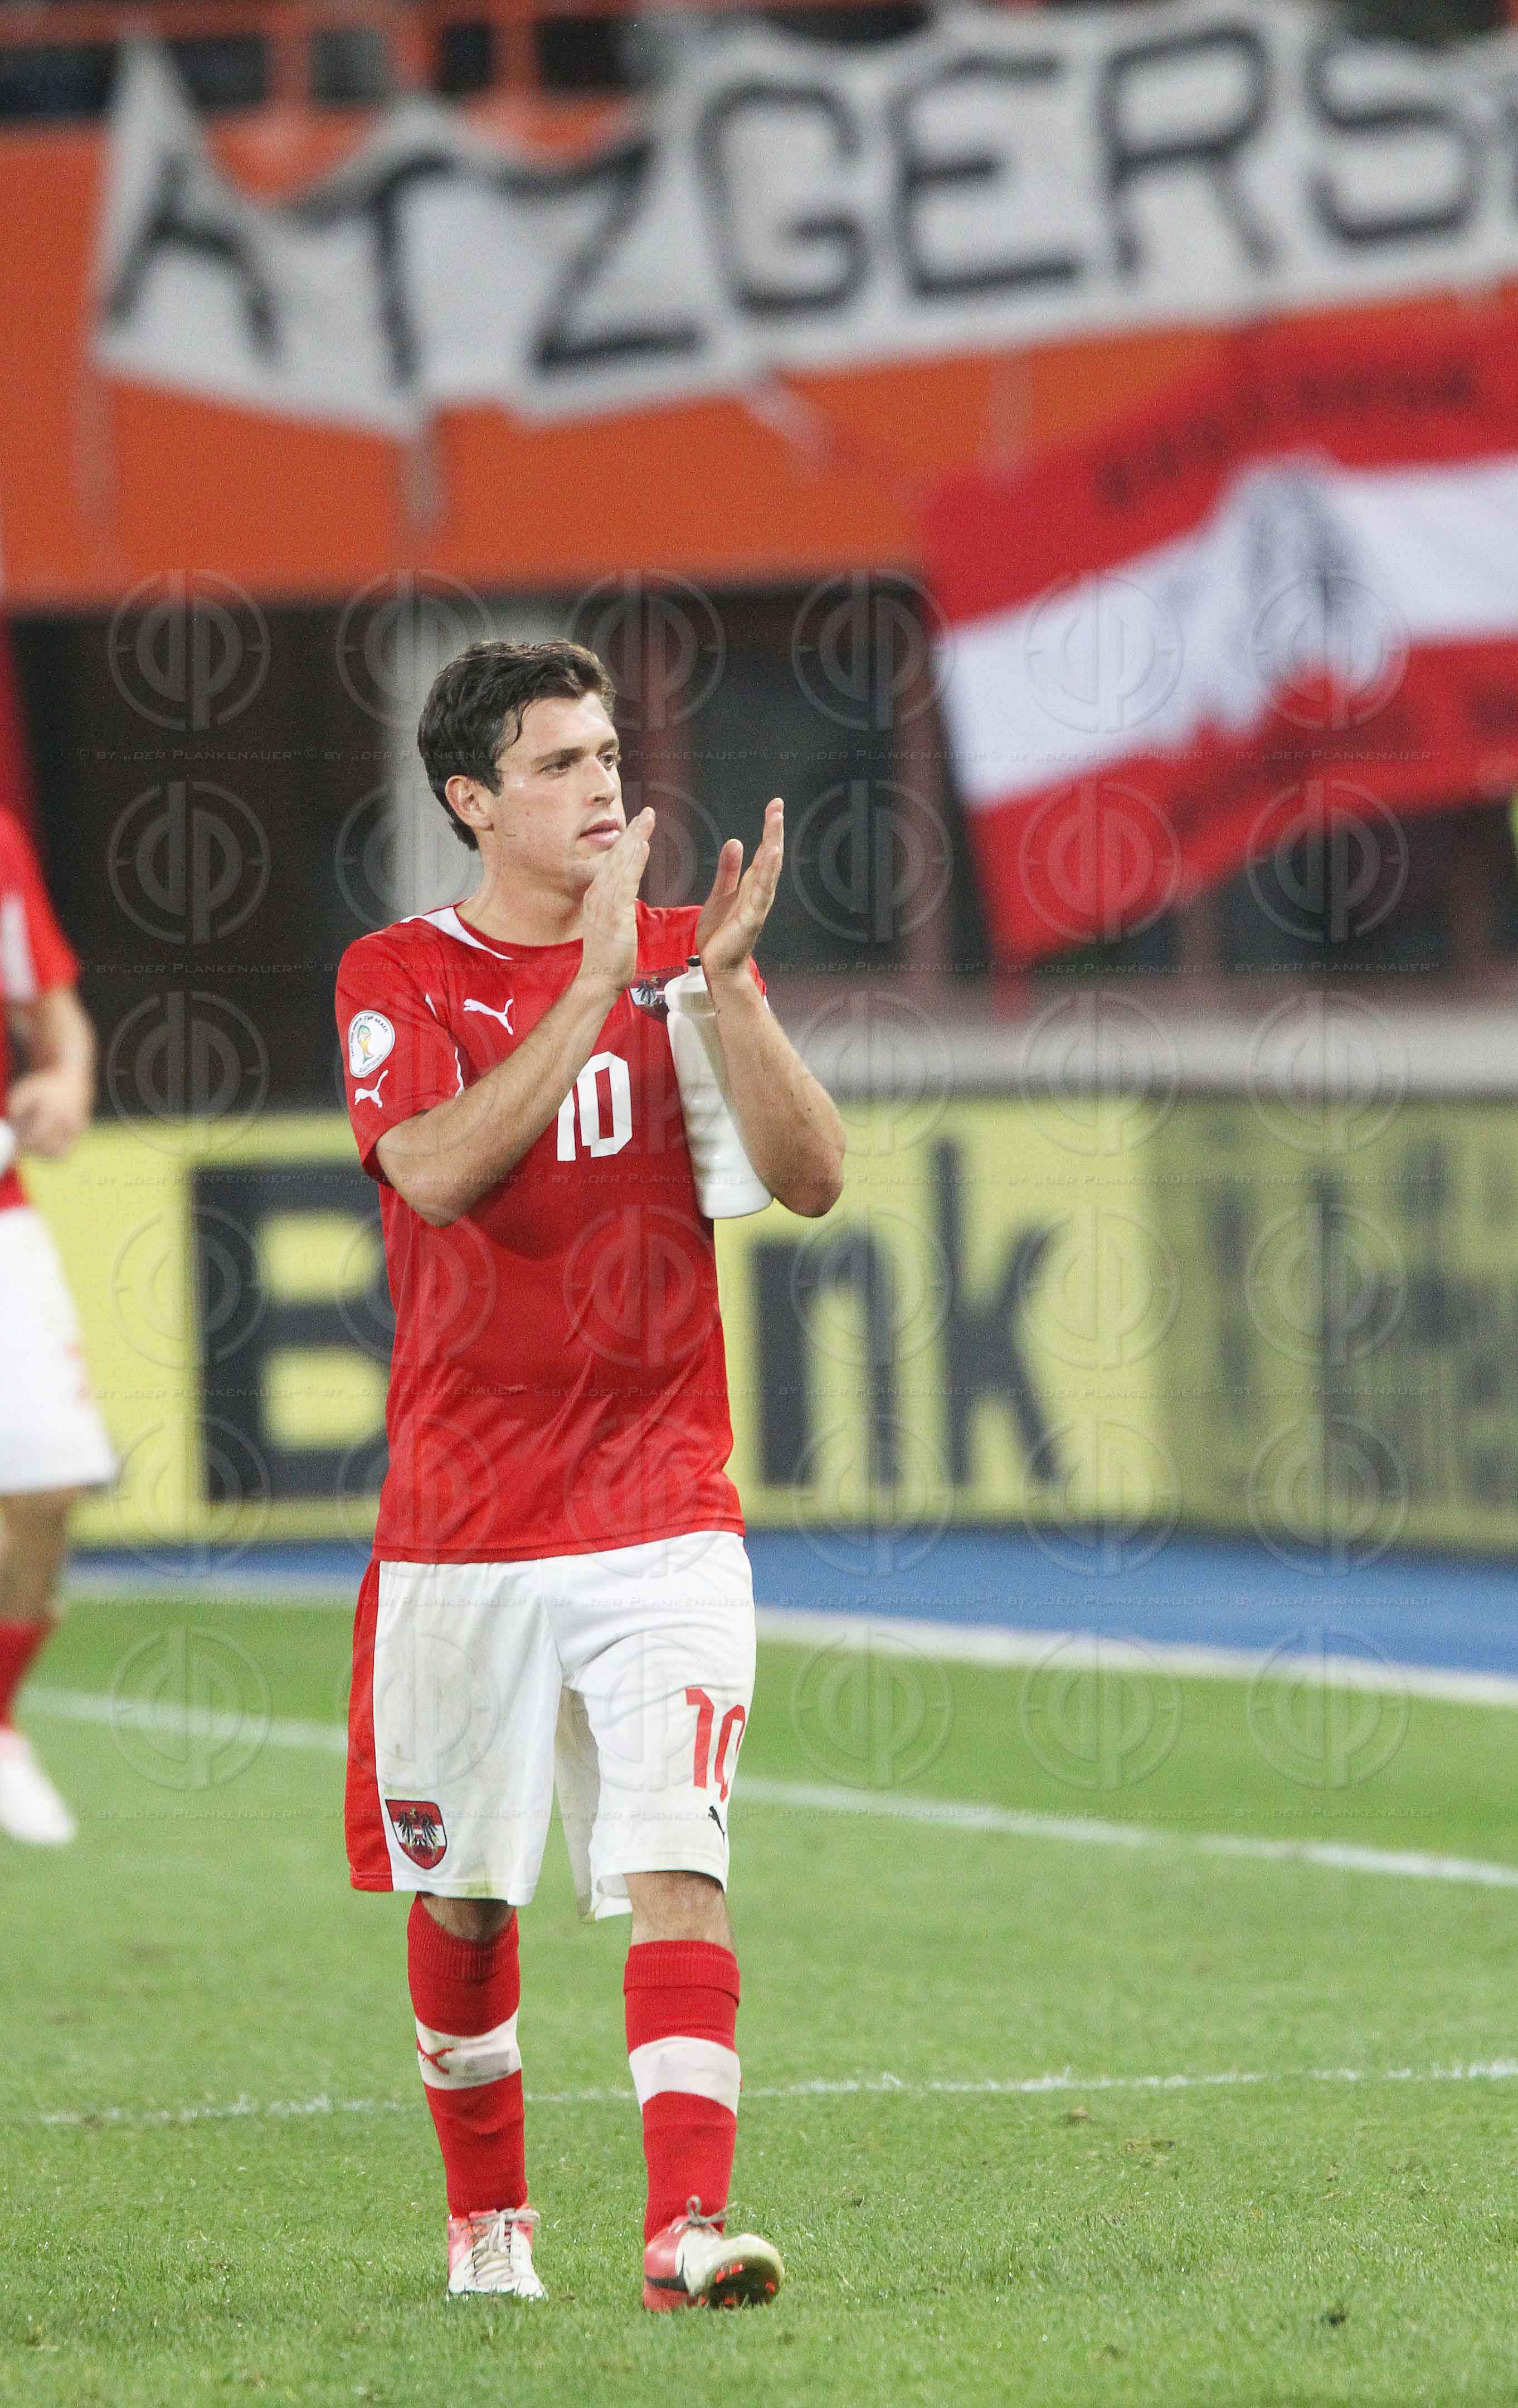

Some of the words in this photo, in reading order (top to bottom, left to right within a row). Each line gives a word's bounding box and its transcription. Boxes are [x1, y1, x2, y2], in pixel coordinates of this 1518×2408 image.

[98, 20, 1518, 390] ATZGERS
[557, 1051, 632, 1161] 10
[685, 1687, 746, 1802] 10
